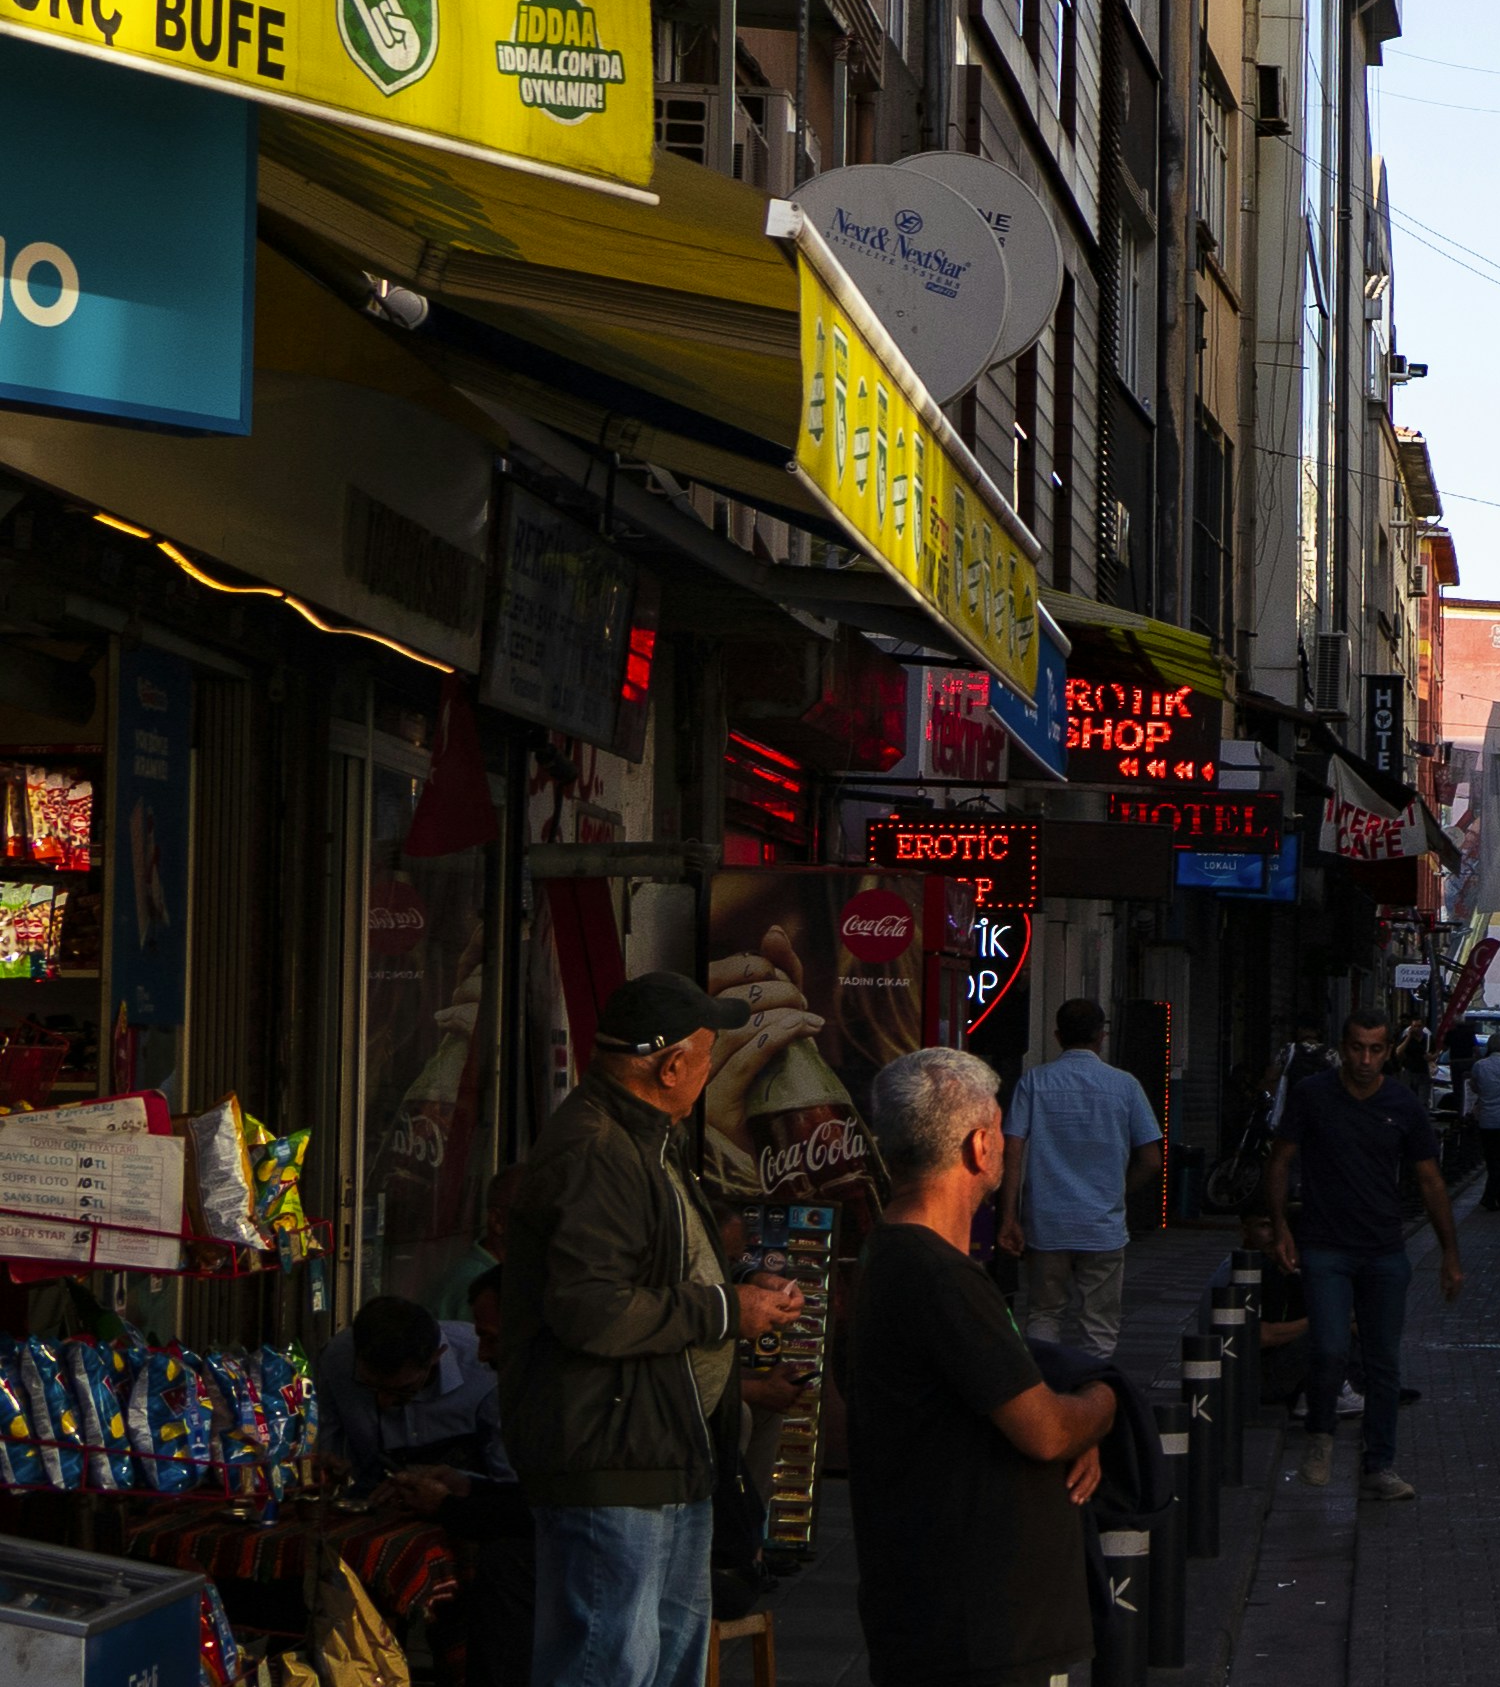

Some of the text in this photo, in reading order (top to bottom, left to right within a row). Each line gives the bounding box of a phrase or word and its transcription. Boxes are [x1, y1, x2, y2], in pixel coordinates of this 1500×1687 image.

[521, 78, 604, 109] OYNANIR!
[825, 231, 961, 290] SATELLITE SYSTEMS
[1374, 688, 1391, 772] HOTE
[1203, 861, 1238, 872] LOKALİ
[842, 914, 911, 938] Coca-Cola
[839, 976, 873, 987] TADINI
[40, 1156, 73, 1167] LOTO
[95, 1160, 107, 1170] TL
[760, 1118, 868, 1194] Coca-Cola
[2, 1171, 36, 1184] SÜPER
[40, 1176, 69, 1187] LOTO
[95, 1180, 107, 1190] TL
[35, 1194, 65, 1206] TOPU
[92, 1199, 105, 1210] TL
[0, 1226, 36, 1240] SÜPER
[38, 1229, 66, 1241] STAR
[1110, 1577, 1137, 1611] K
